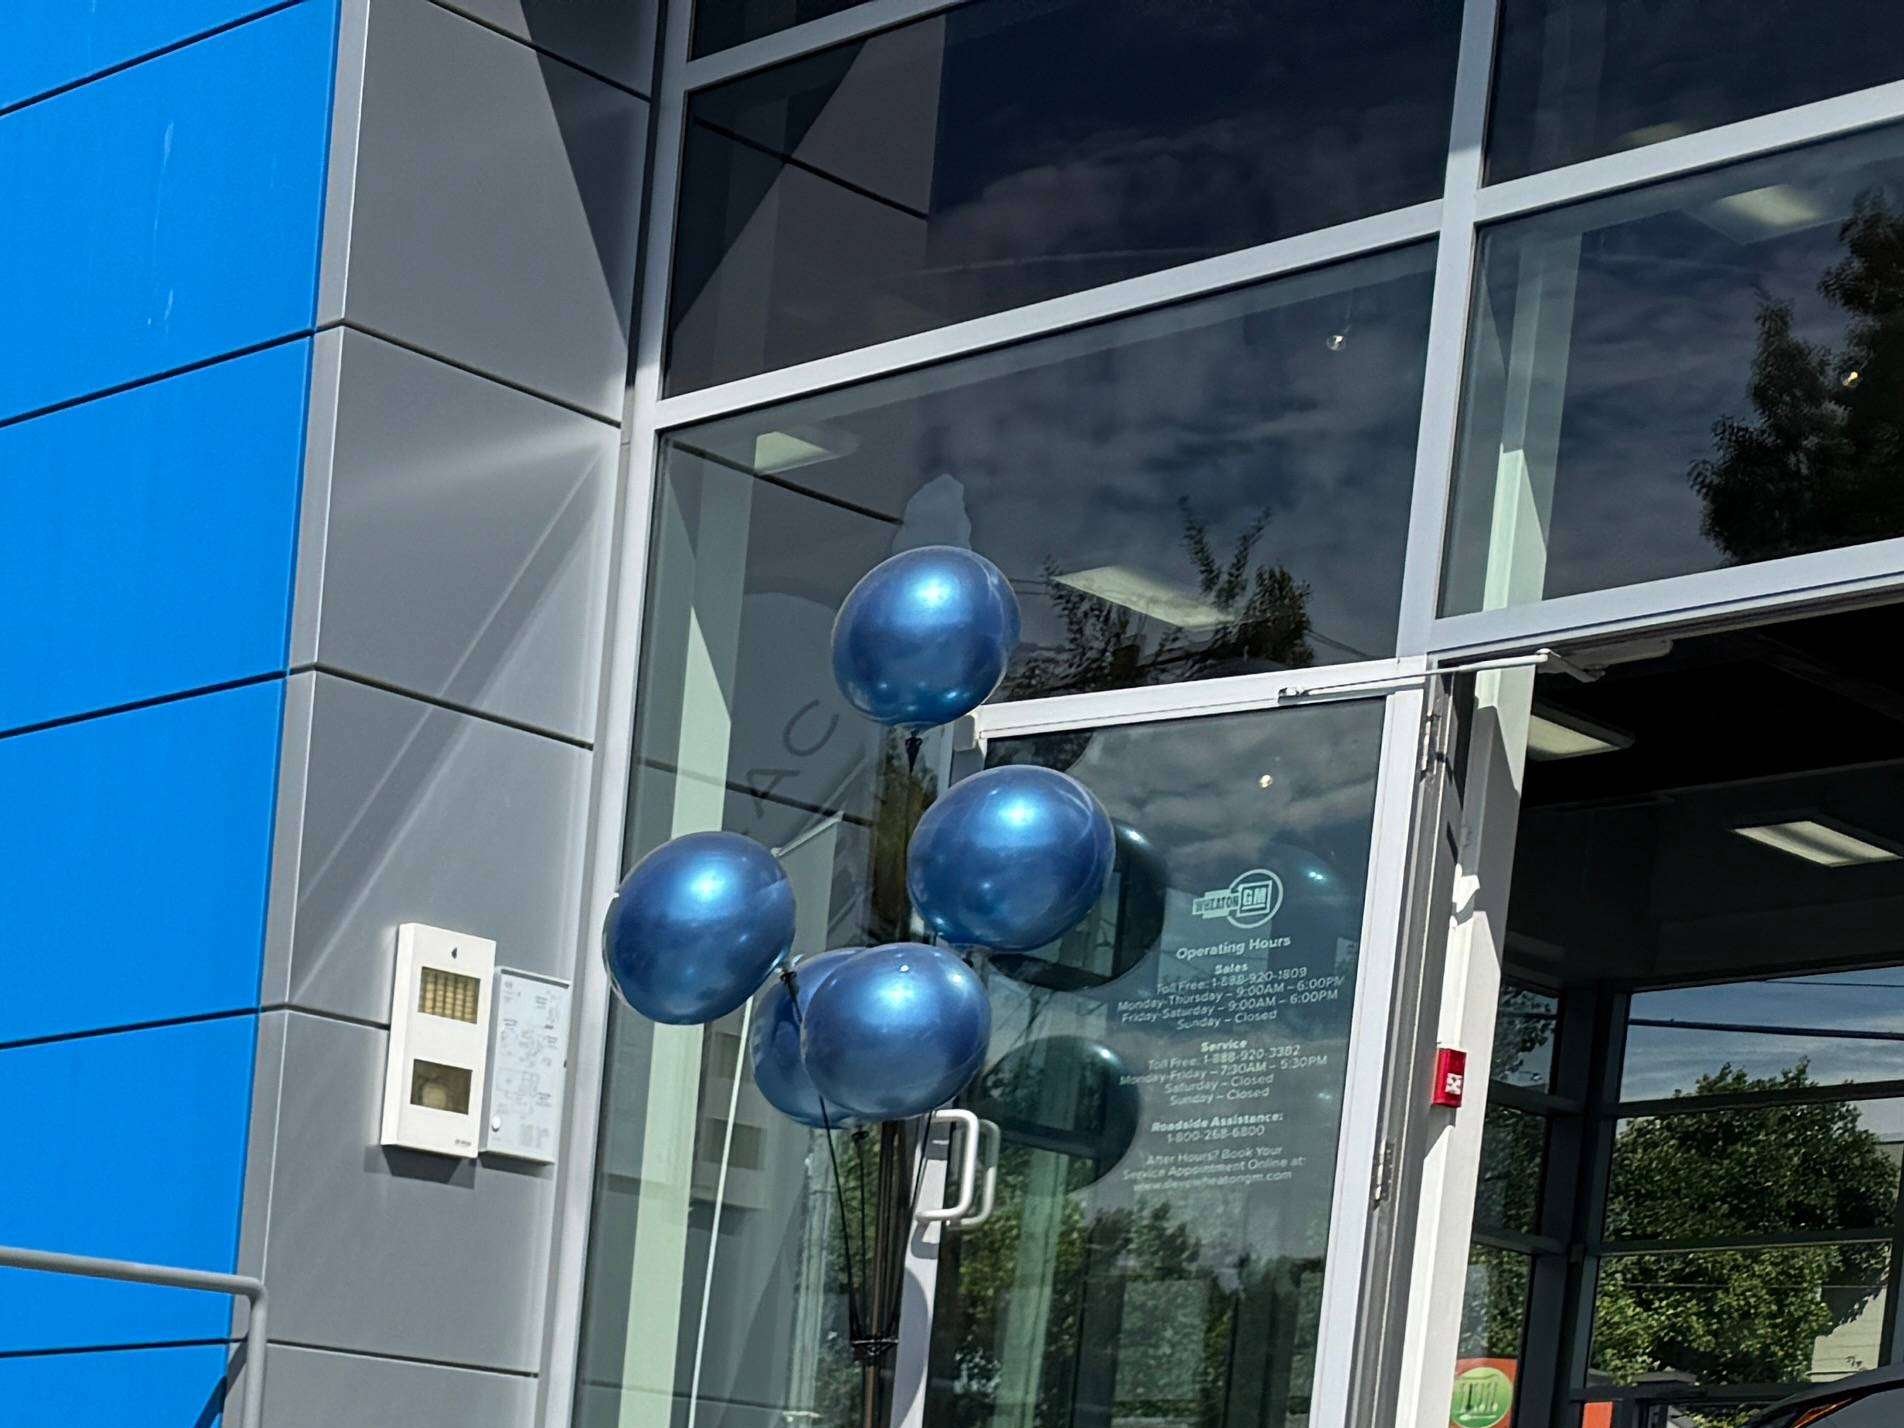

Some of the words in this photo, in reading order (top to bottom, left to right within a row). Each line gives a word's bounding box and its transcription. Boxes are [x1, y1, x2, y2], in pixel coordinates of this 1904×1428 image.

[1243, 887, 1268, 906] GM
[1175, 942, 1246, 961] Operating
[1249, 936, 1292, 951] Hours
[1214, 963, 1249, 975] Sales
[1176, 1017, 1222, 1030] Sunday
[1234, 1010, 1278, 1024] Closed
[1200, 1039, 1248, 1053] Service
[1165, 1079, 1218, 1094] Saturday
[1230, 1074, 1275, 1087] Closed
[1226, 1087, 1270, 1100] Closed
[1151, 1118, 1209, 1132] Roadside
[1210, 1111, 1284, 1127] Assistance:
[1248, 1157, 1288, 1170] Online
